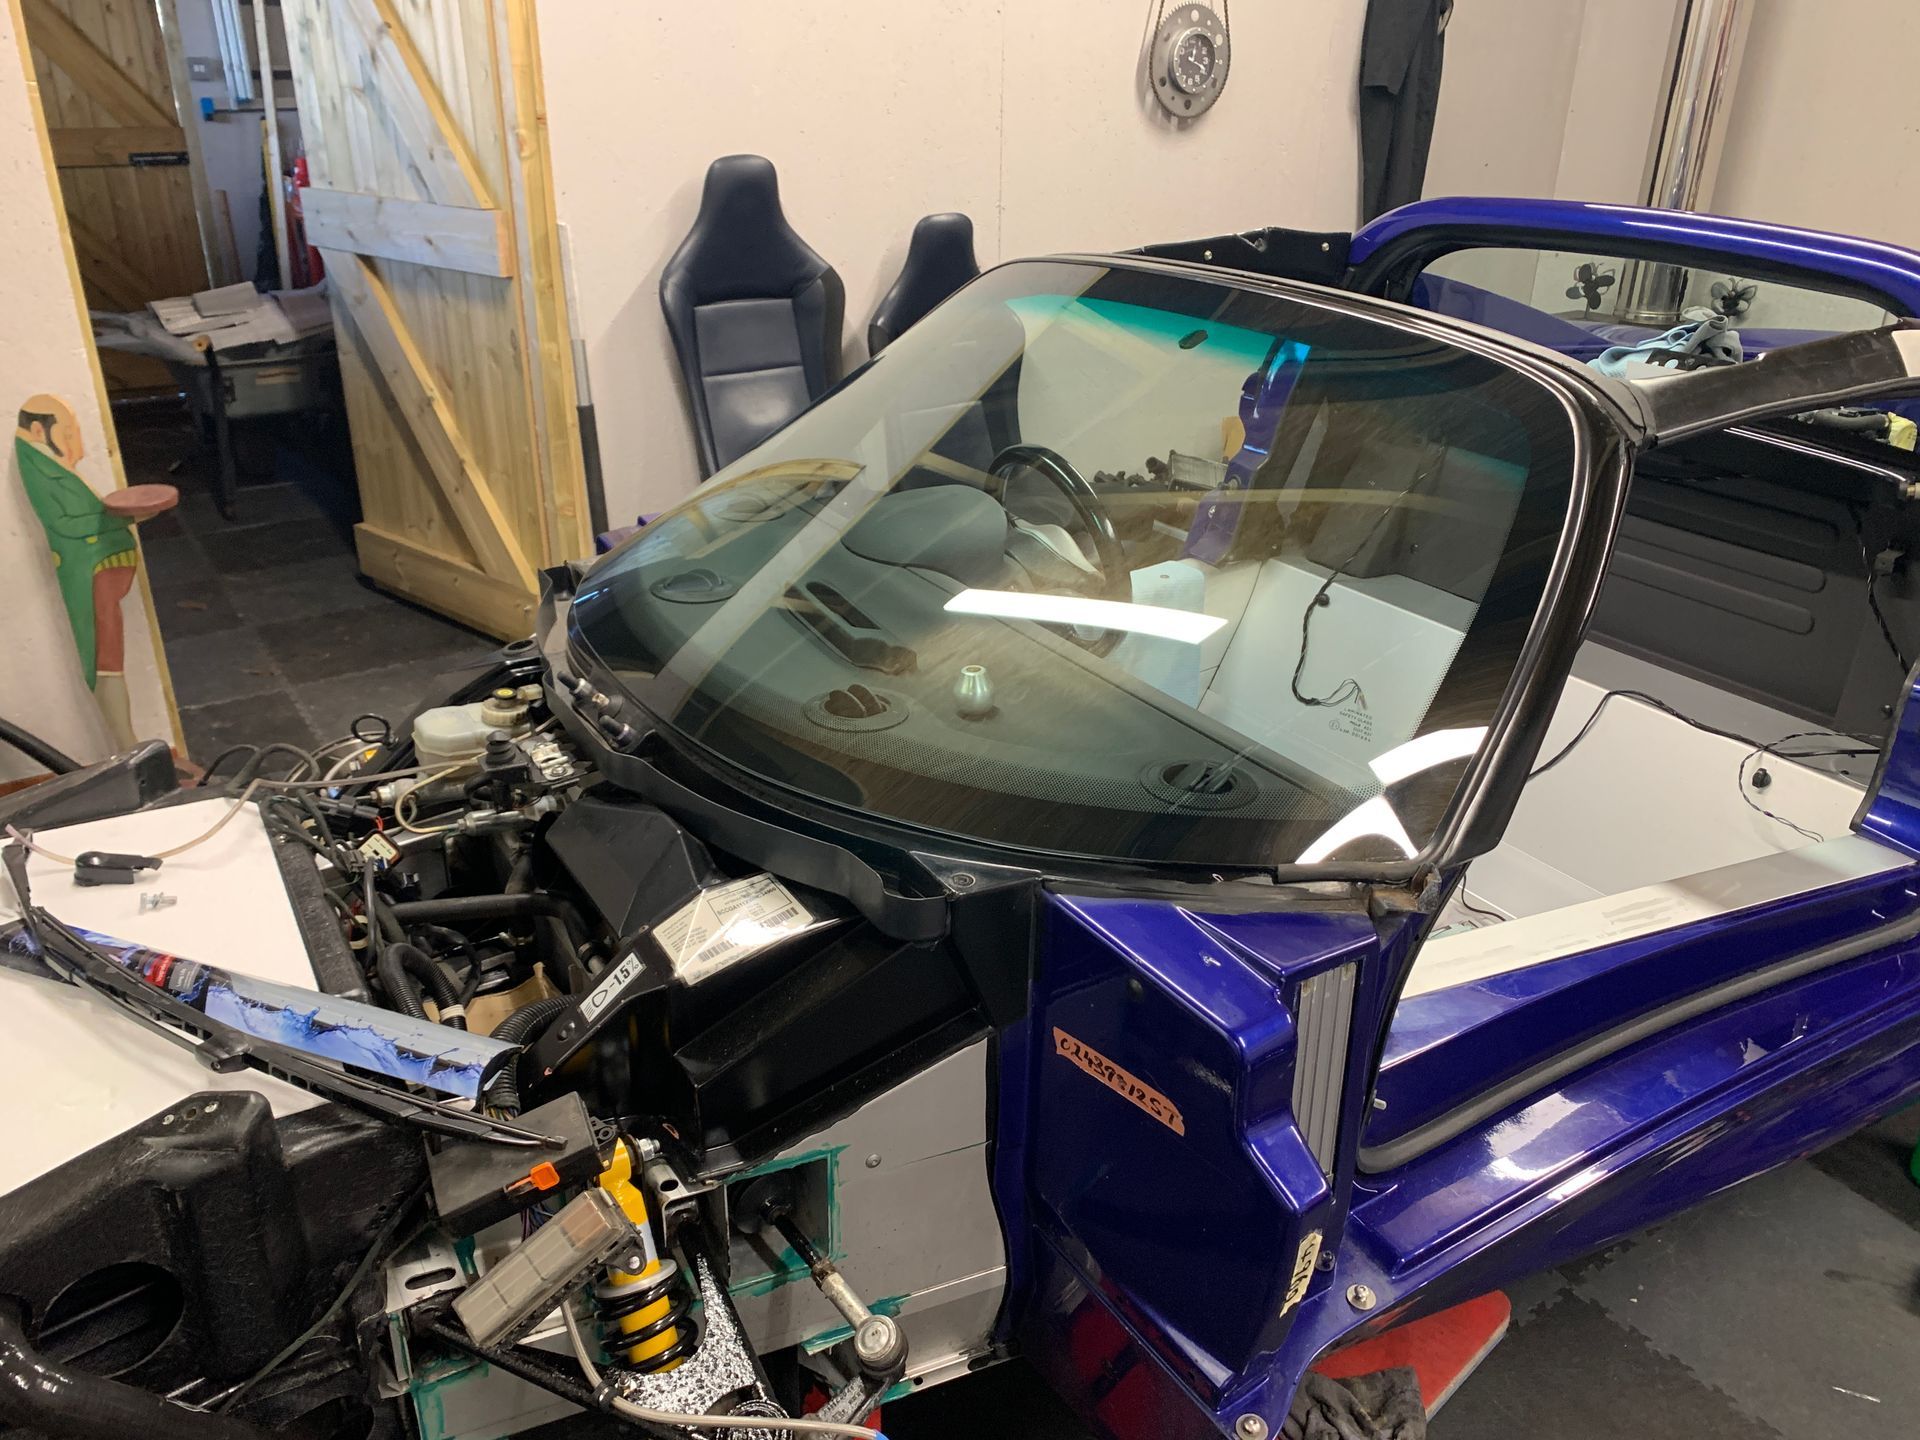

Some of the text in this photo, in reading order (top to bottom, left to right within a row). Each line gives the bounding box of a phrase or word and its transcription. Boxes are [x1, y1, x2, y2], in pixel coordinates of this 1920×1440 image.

[1202, 56, 1209, 65] 3
[1339, 711, 1357, 721] SAFETY
[1343, 707, 1373, 721] LAMINATED
